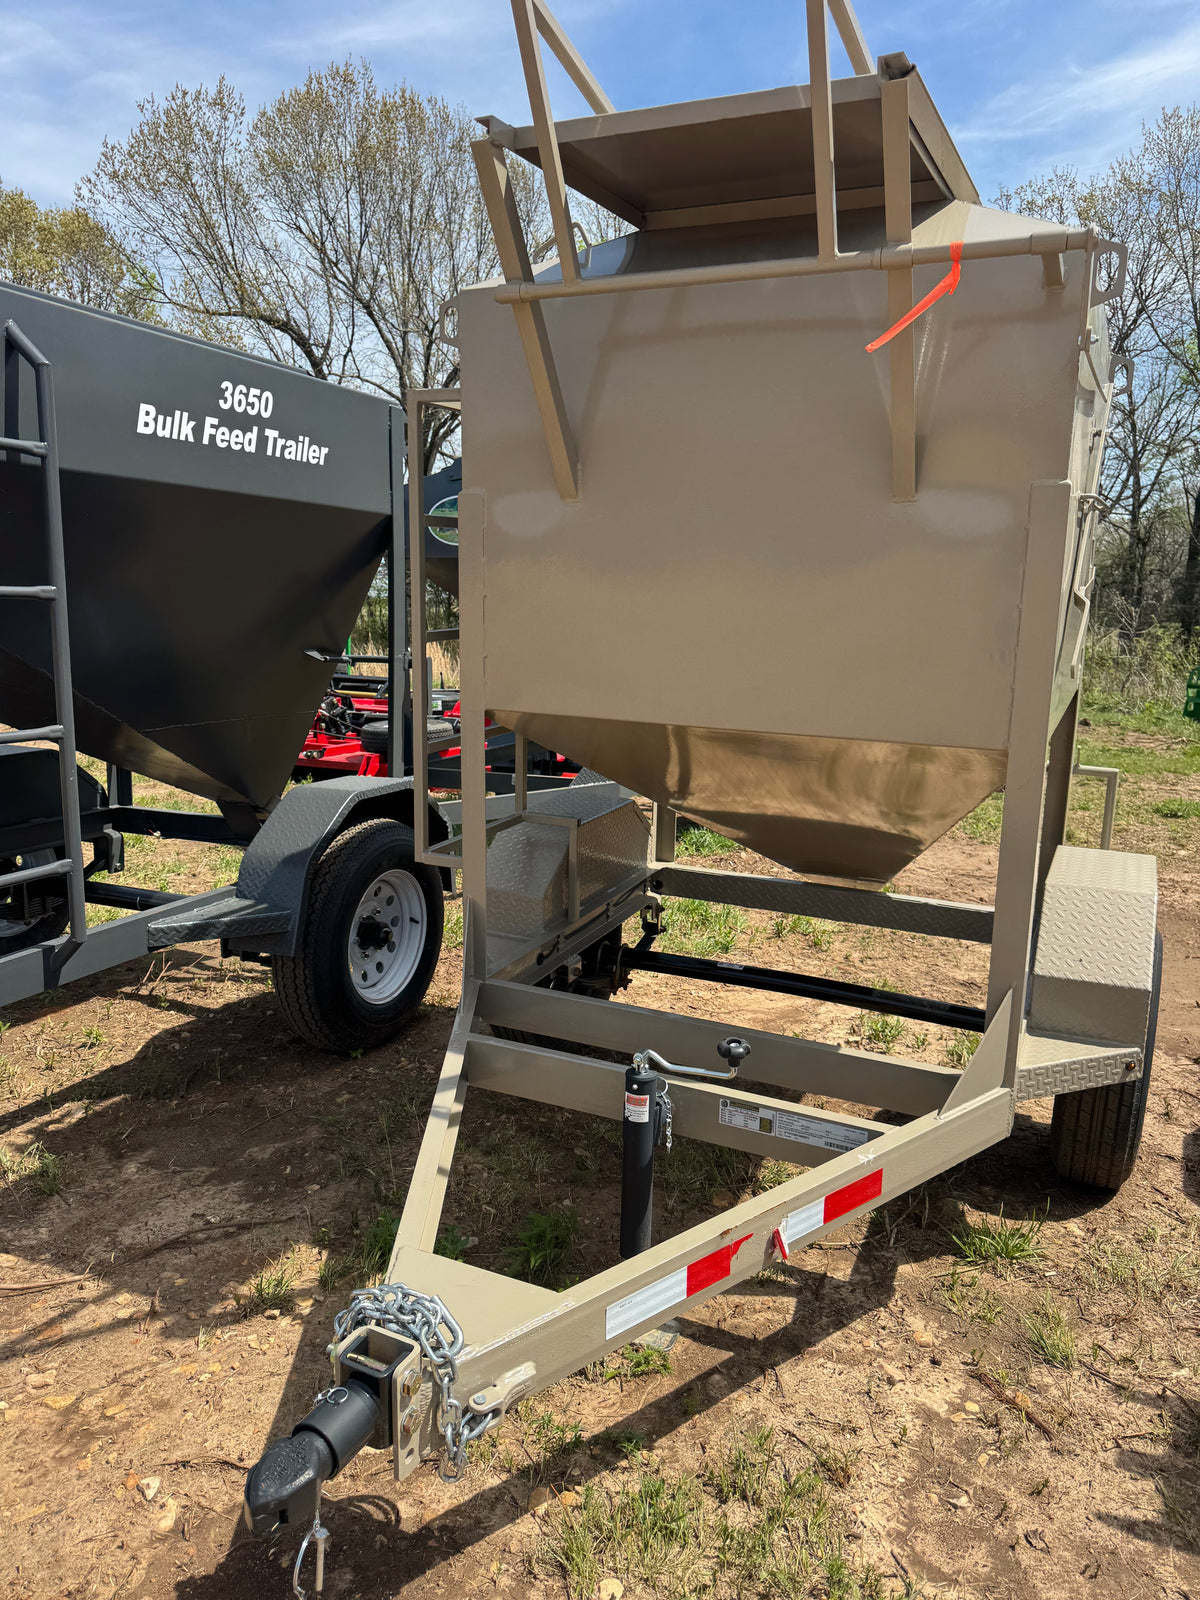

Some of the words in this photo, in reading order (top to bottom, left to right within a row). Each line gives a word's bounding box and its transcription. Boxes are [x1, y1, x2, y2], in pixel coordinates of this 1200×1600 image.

[218, 380, 274, 419] 3650
[136, 402, 197, 443] Bulk
[202, 415, 259, 454] Feed
[264, 428, 329, 466] Trailer
